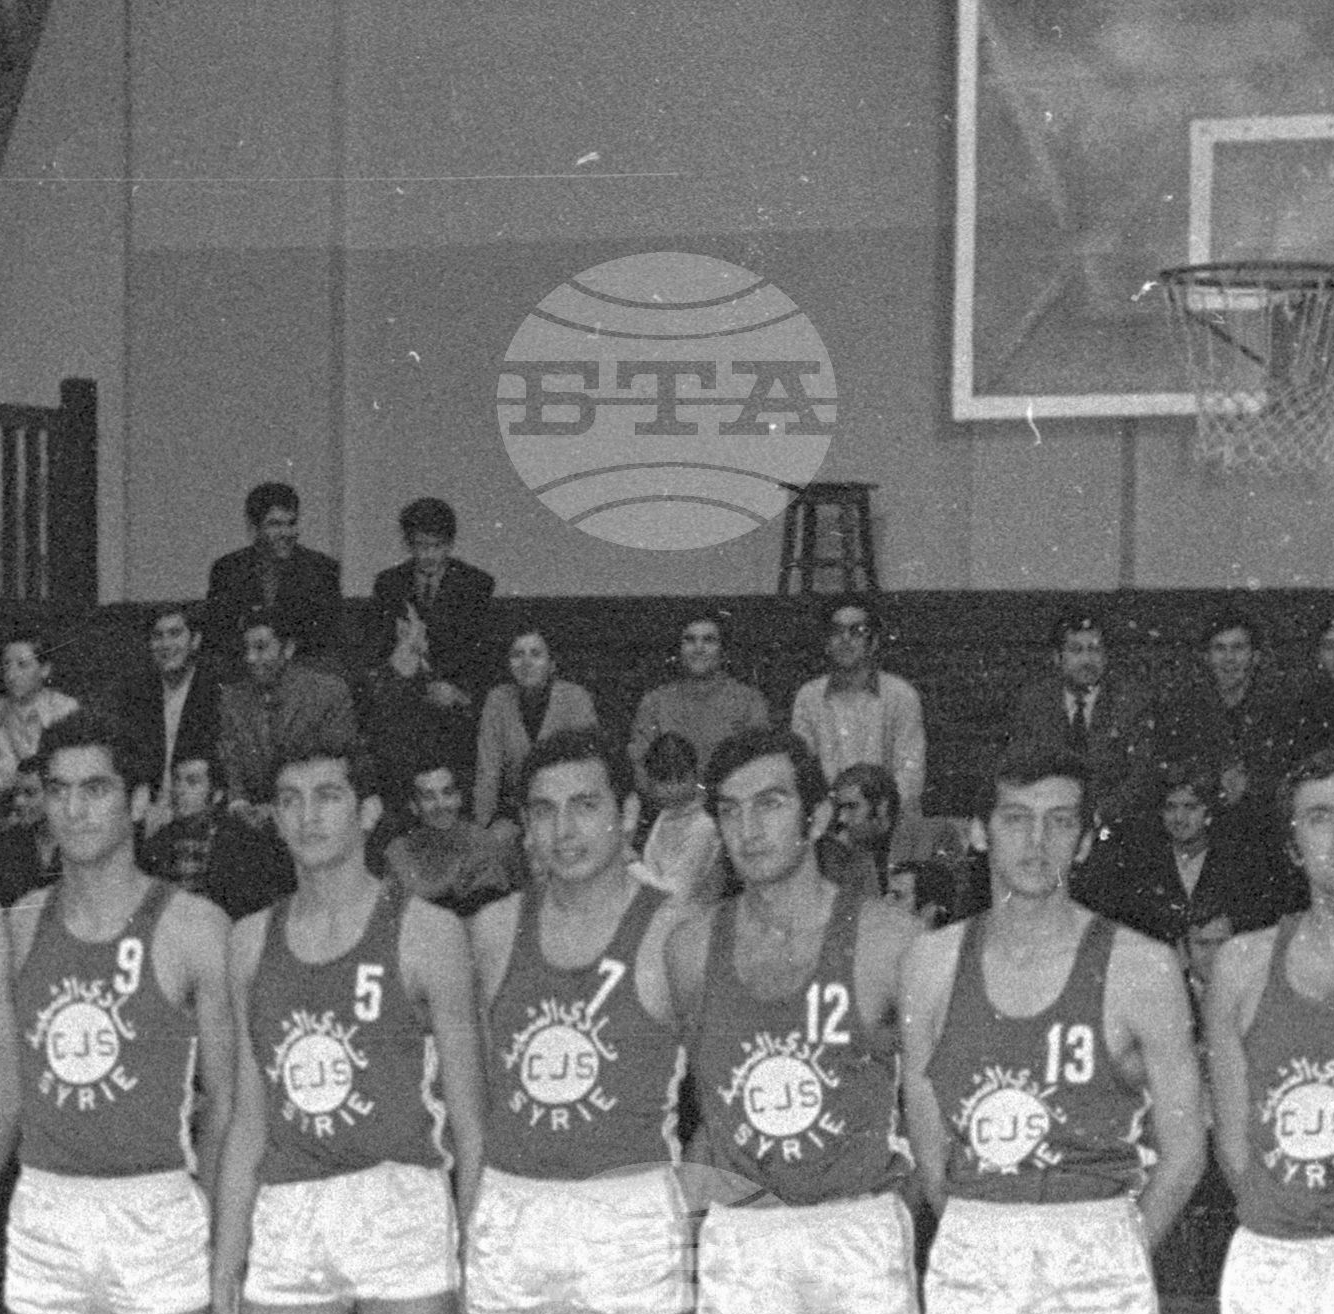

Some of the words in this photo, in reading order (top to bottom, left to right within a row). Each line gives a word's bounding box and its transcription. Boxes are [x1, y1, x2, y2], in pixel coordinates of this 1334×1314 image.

[113, 938, 143, 994] 9
[584, 958, 625, 1016] 7
[354, 963, 384, 1021] 5
[806, 983, 850, 1043] 12
[52, 1031, 114, 1060] CJS
[529, 1053, 593, 1080] CJS
[1046, 1023, 1094, 1083] 13
[38, 1066, 138, 1110] SYRIE
[291, 1060, 348, 1090] CJS
[750, 1080, 818, 1112] CJS
[509, 1087, 618, 1131] SYRIE
[977, 1114, 1043, 1144] CJS
[734, 1112, 846, 1162] SYRIE
